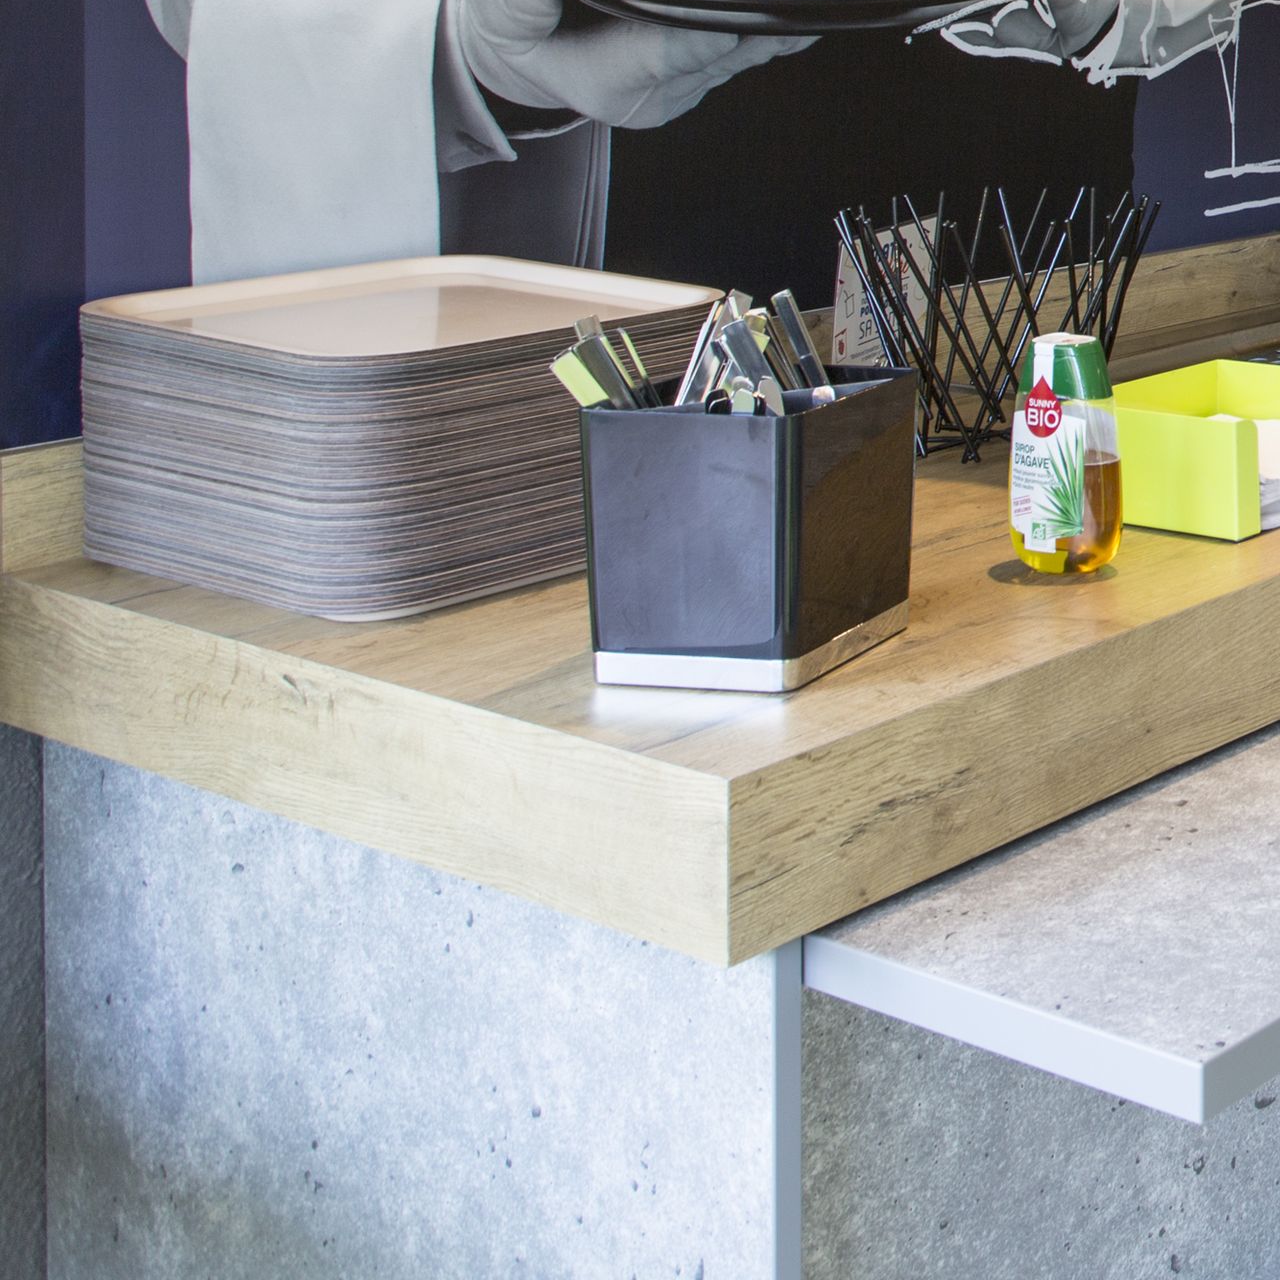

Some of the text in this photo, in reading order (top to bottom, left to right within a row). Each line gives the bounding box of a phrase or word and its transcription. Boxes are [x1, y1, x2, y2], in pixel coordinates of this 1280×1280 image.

[1028, 397, 1057, 409] SUNNY
[1027, 407, 1060, 429] BIO
[1014, 442, 1036, 456] SIROP
[1014, 452, 1051, 470] D'AGAVE
